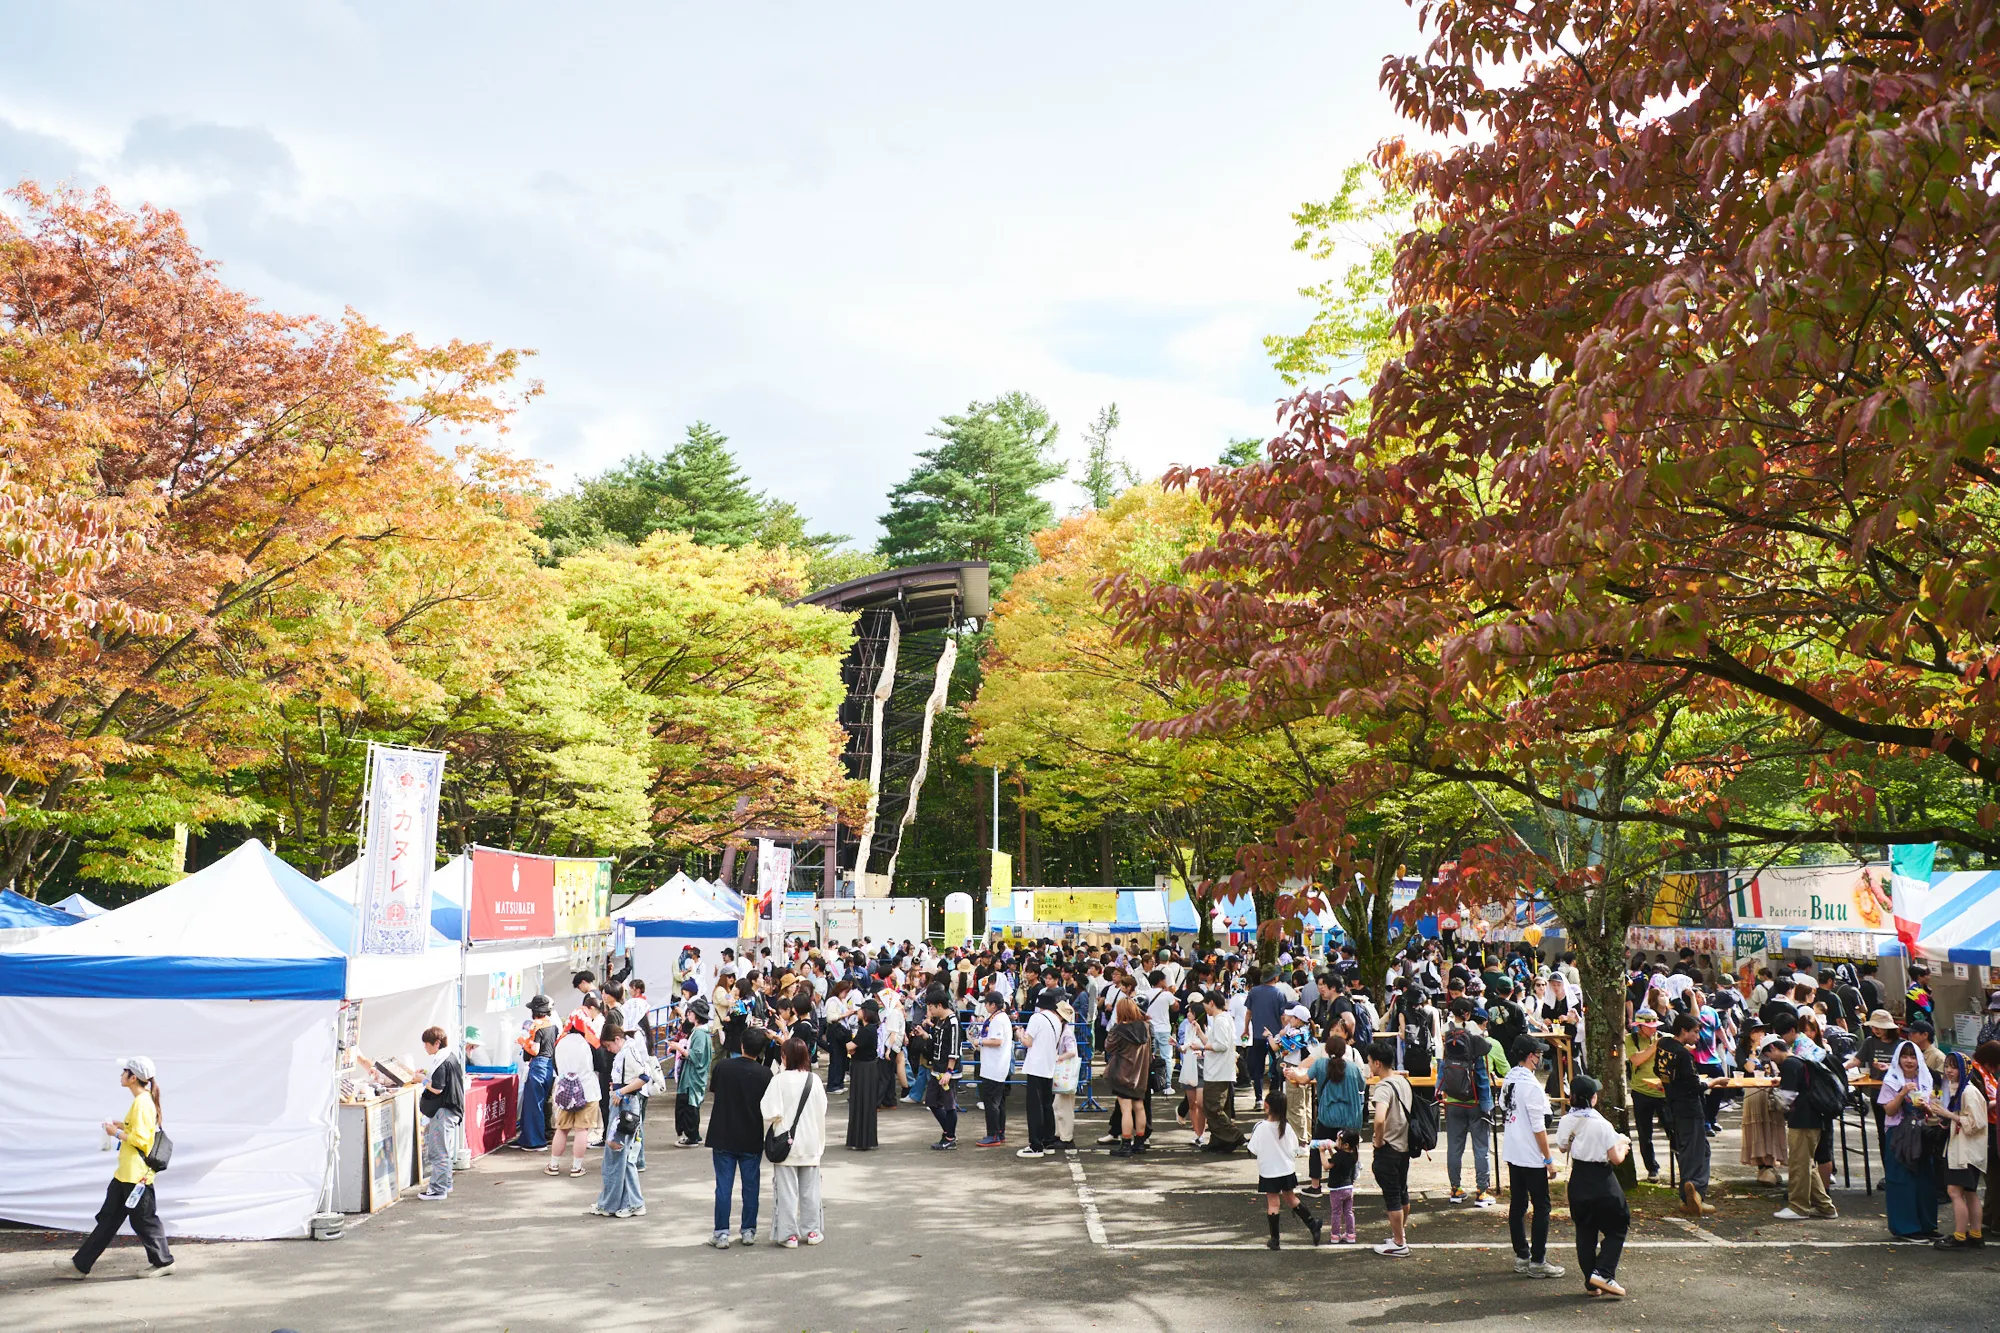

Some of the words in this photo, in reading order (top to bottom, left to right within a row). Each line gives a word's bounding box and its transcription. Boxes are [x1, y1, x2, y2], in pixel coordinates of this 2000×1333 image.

[390, 809, 413, 892] カヌレ
[495, 901, 535, 915] MATSUBAEN
[1769, 905, 1807, 917] Pasteria
[1810, 895, 1847, 921] Buu
[1736, 932, 1765, 945] イタリアン
[1738, 945, 1751, 957] BOX
